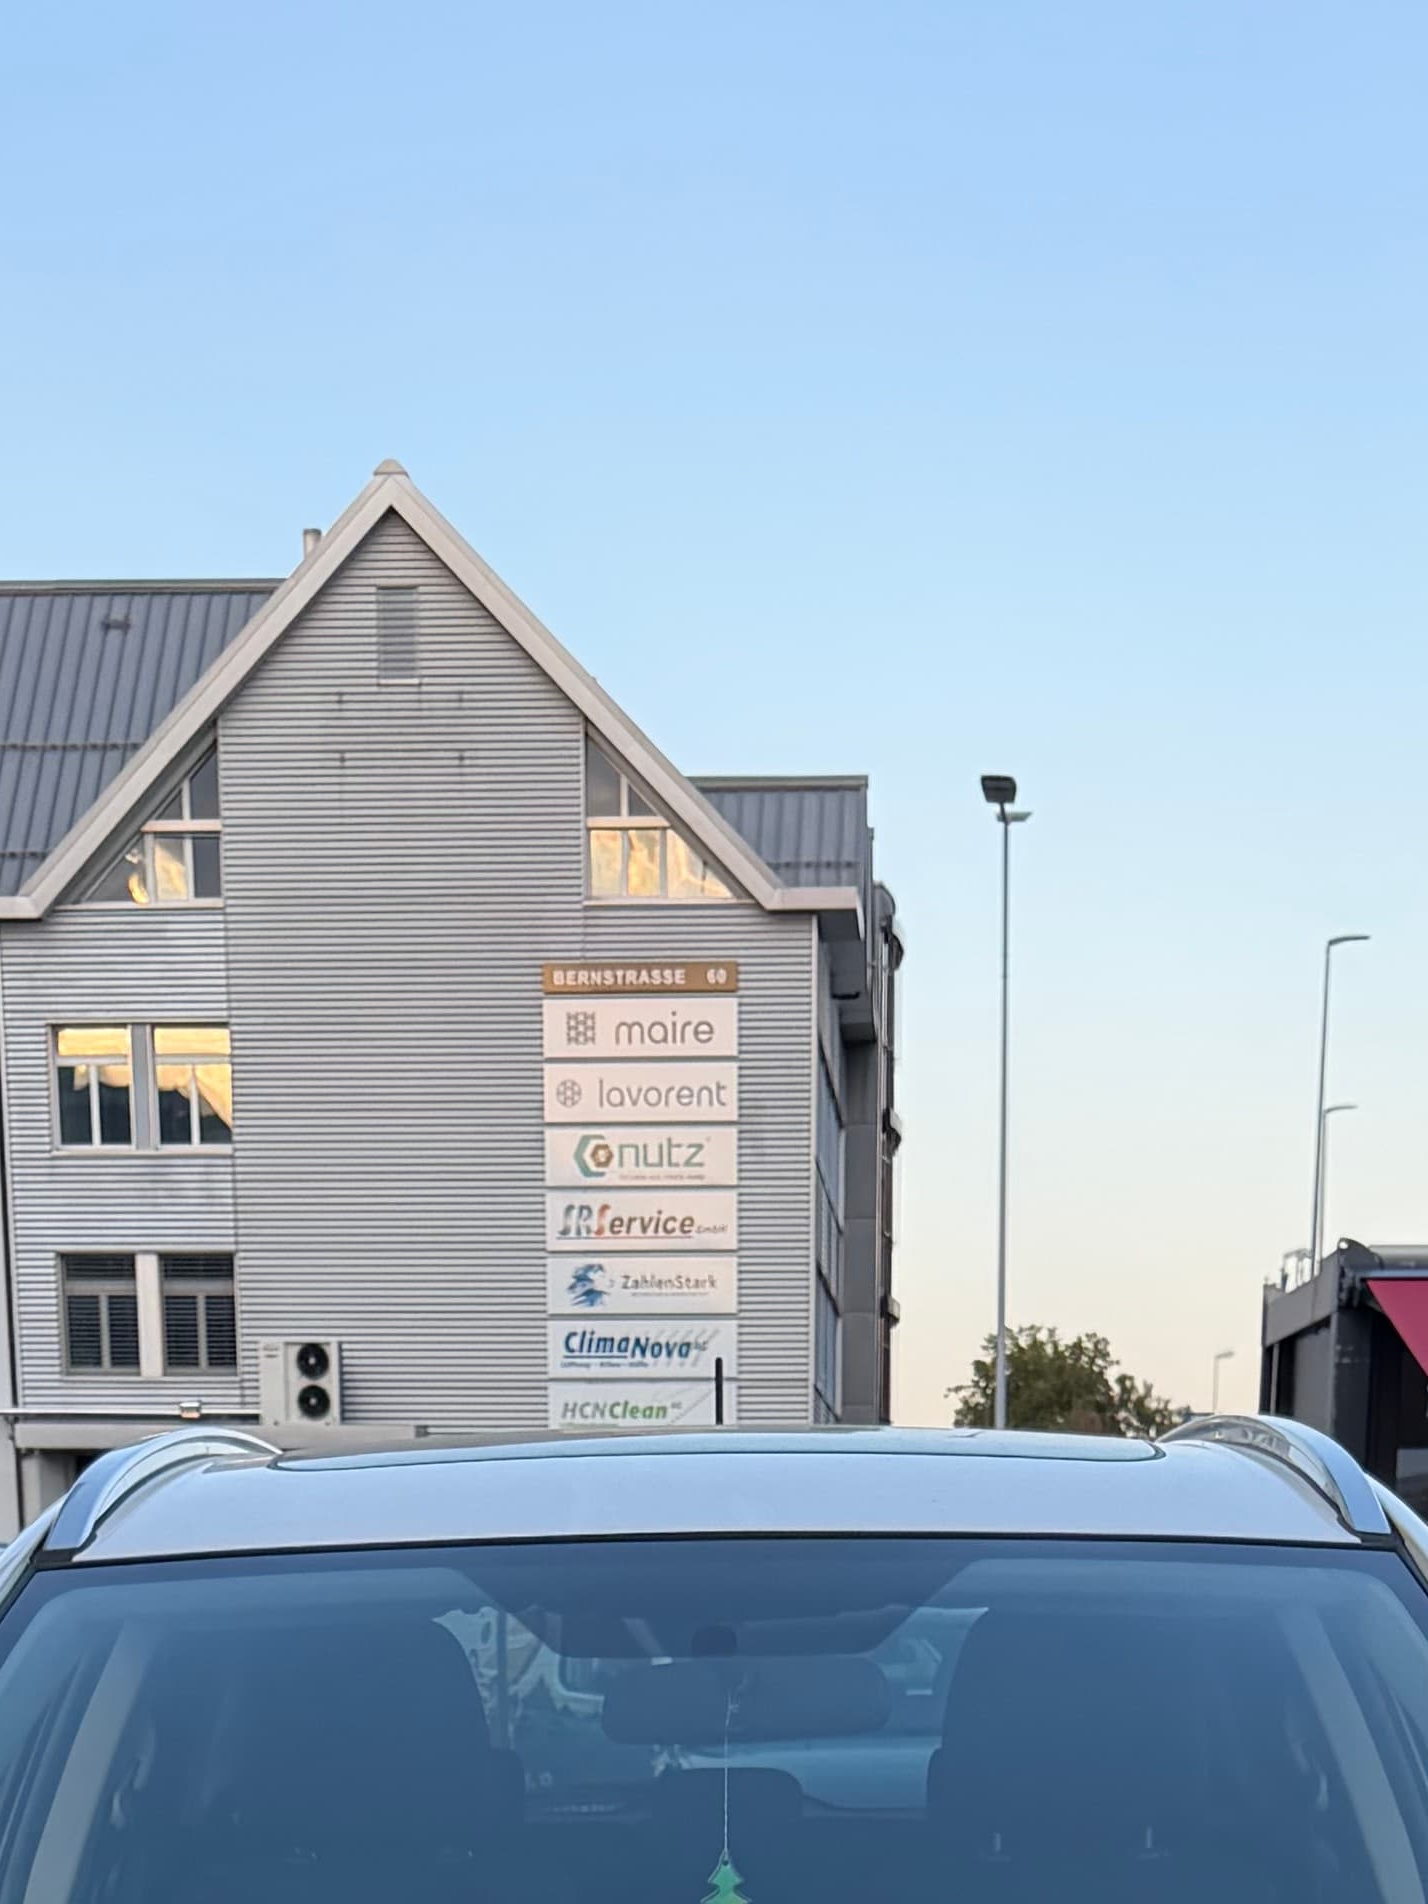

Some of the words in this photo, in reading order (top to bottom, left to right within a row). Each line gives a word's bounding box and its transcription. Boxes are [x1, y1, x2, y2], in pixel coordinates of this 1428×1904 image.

[552, 968, 686, 986] BERNSTRASSE
[706, 967, 728, 984] 60
[614, 1010, 715, 1046] maire
[598, 1078, 727, 1109] lavorent
[617, 1136, 705, 1168] nutz
[563, 1329, 693, 1360] ClimaNova
[561, 1399, 668, 1420] HCNClean
